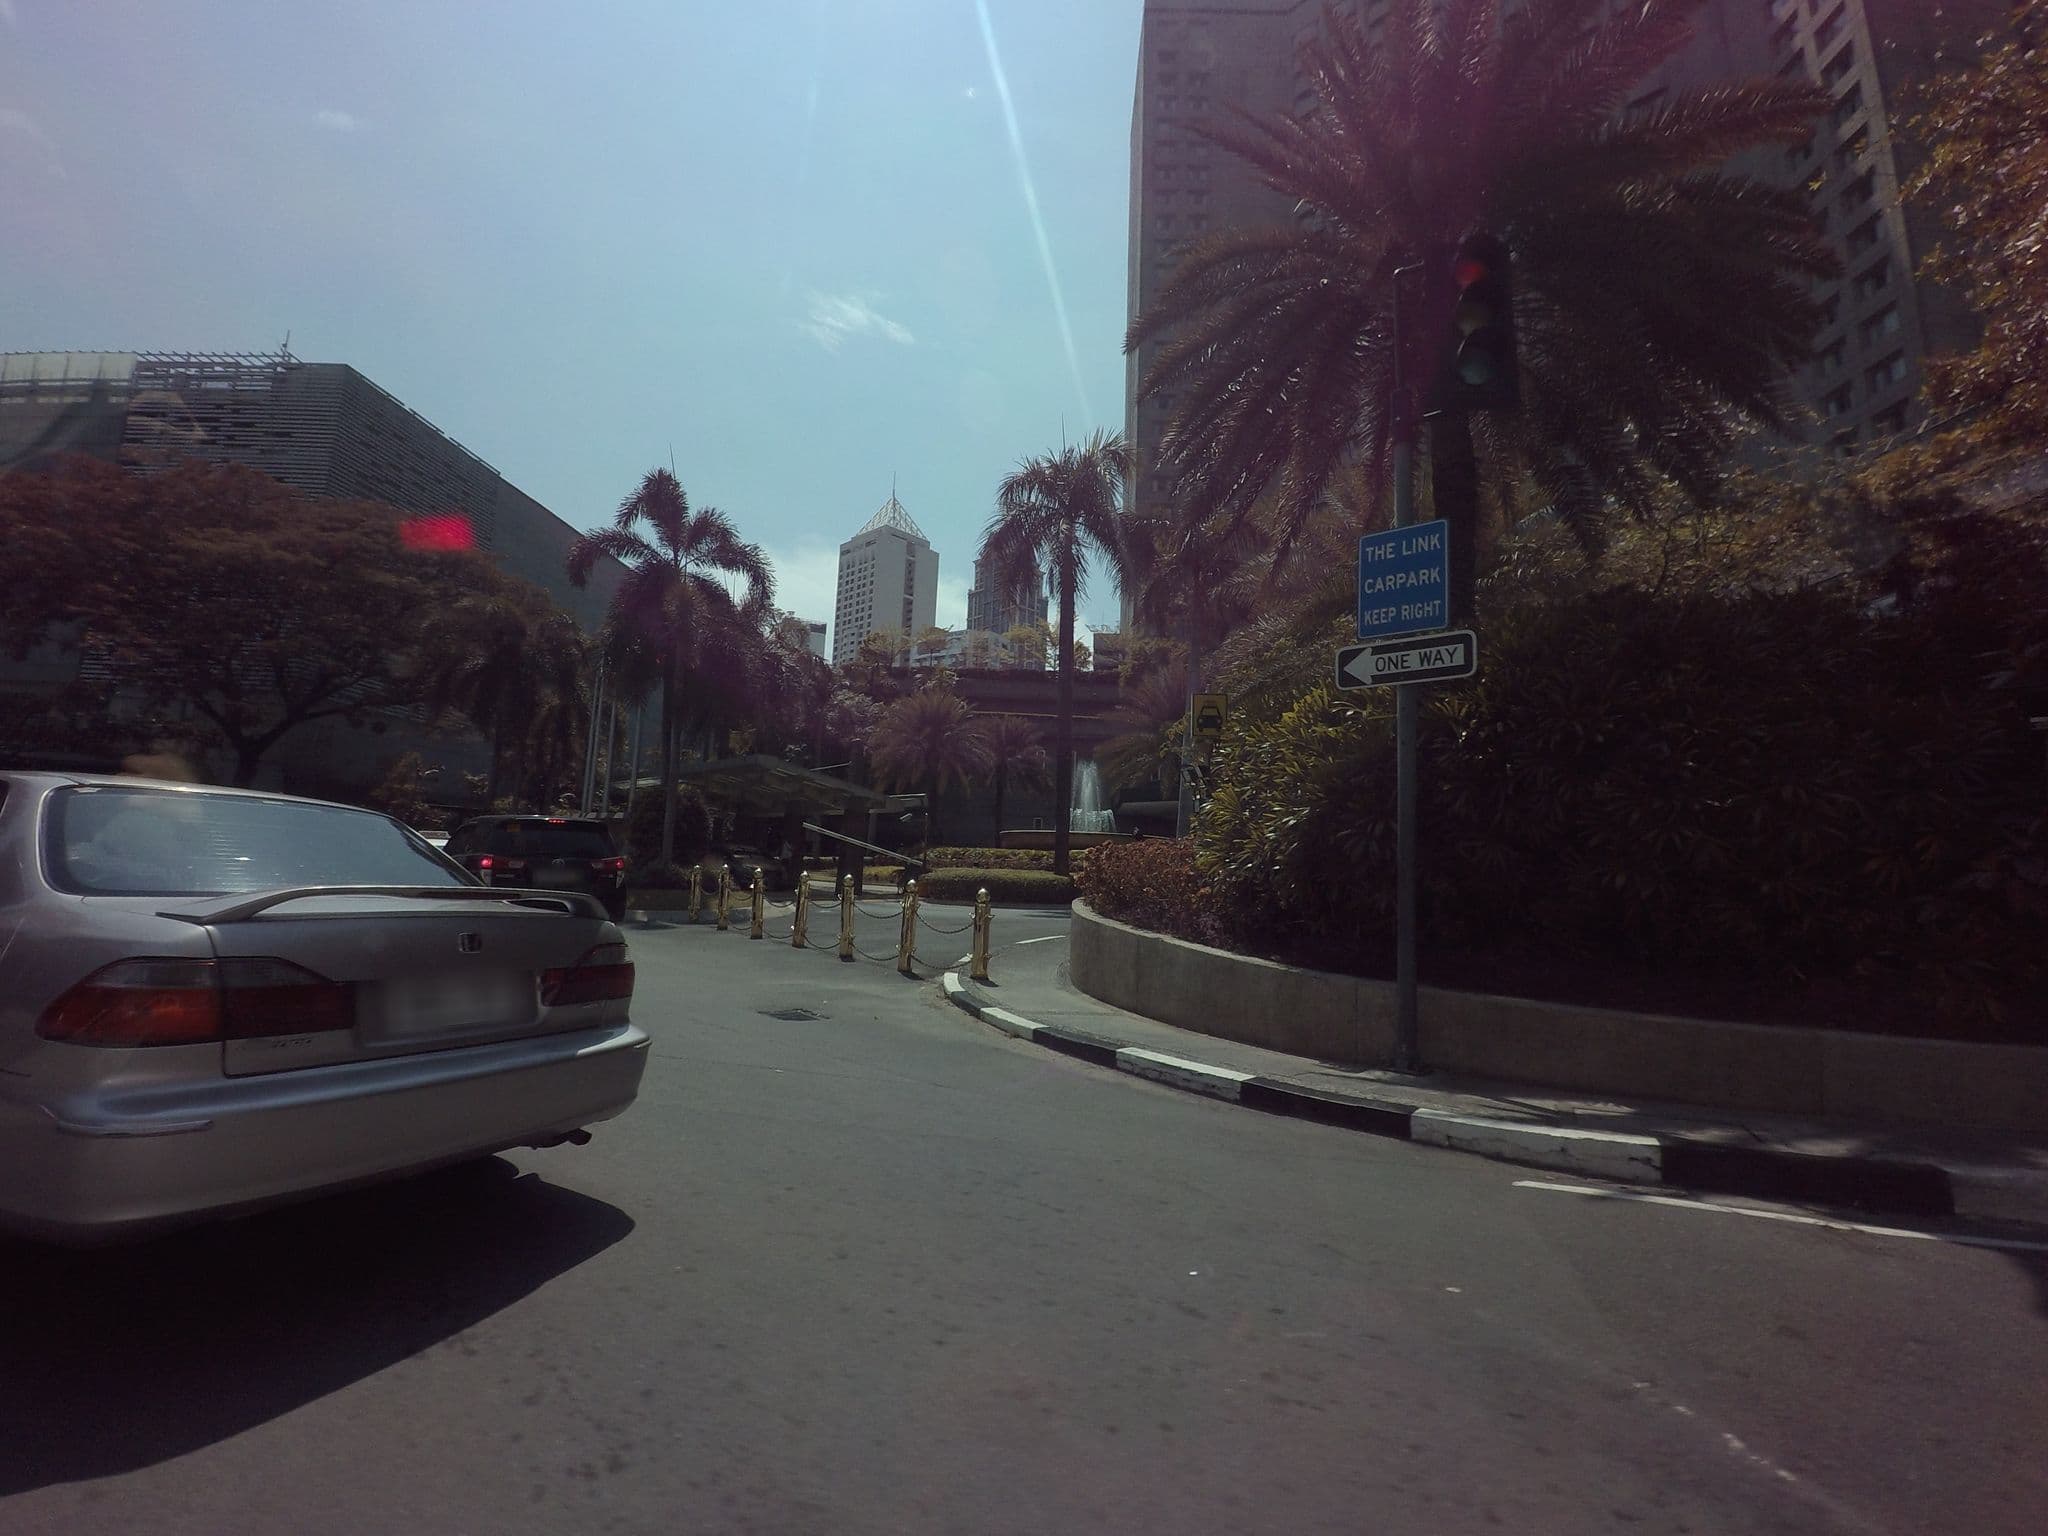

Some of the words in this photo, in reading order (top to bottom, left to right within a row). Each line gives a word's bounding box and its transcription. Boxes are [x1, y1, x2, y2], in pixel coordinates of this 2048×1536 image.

[1365, 543, 1396, 562] THE
[1402, 533, 1441, 556] LINK
[1364, 567, 1441, 594] CARPARK
[1364, 607, 1396, 626] KEEP
[1401, 600, 1441, 620] RIGHT
[1375, 653, 1411, 673] ONE
[1418, 647, 1458, 667] WAY
